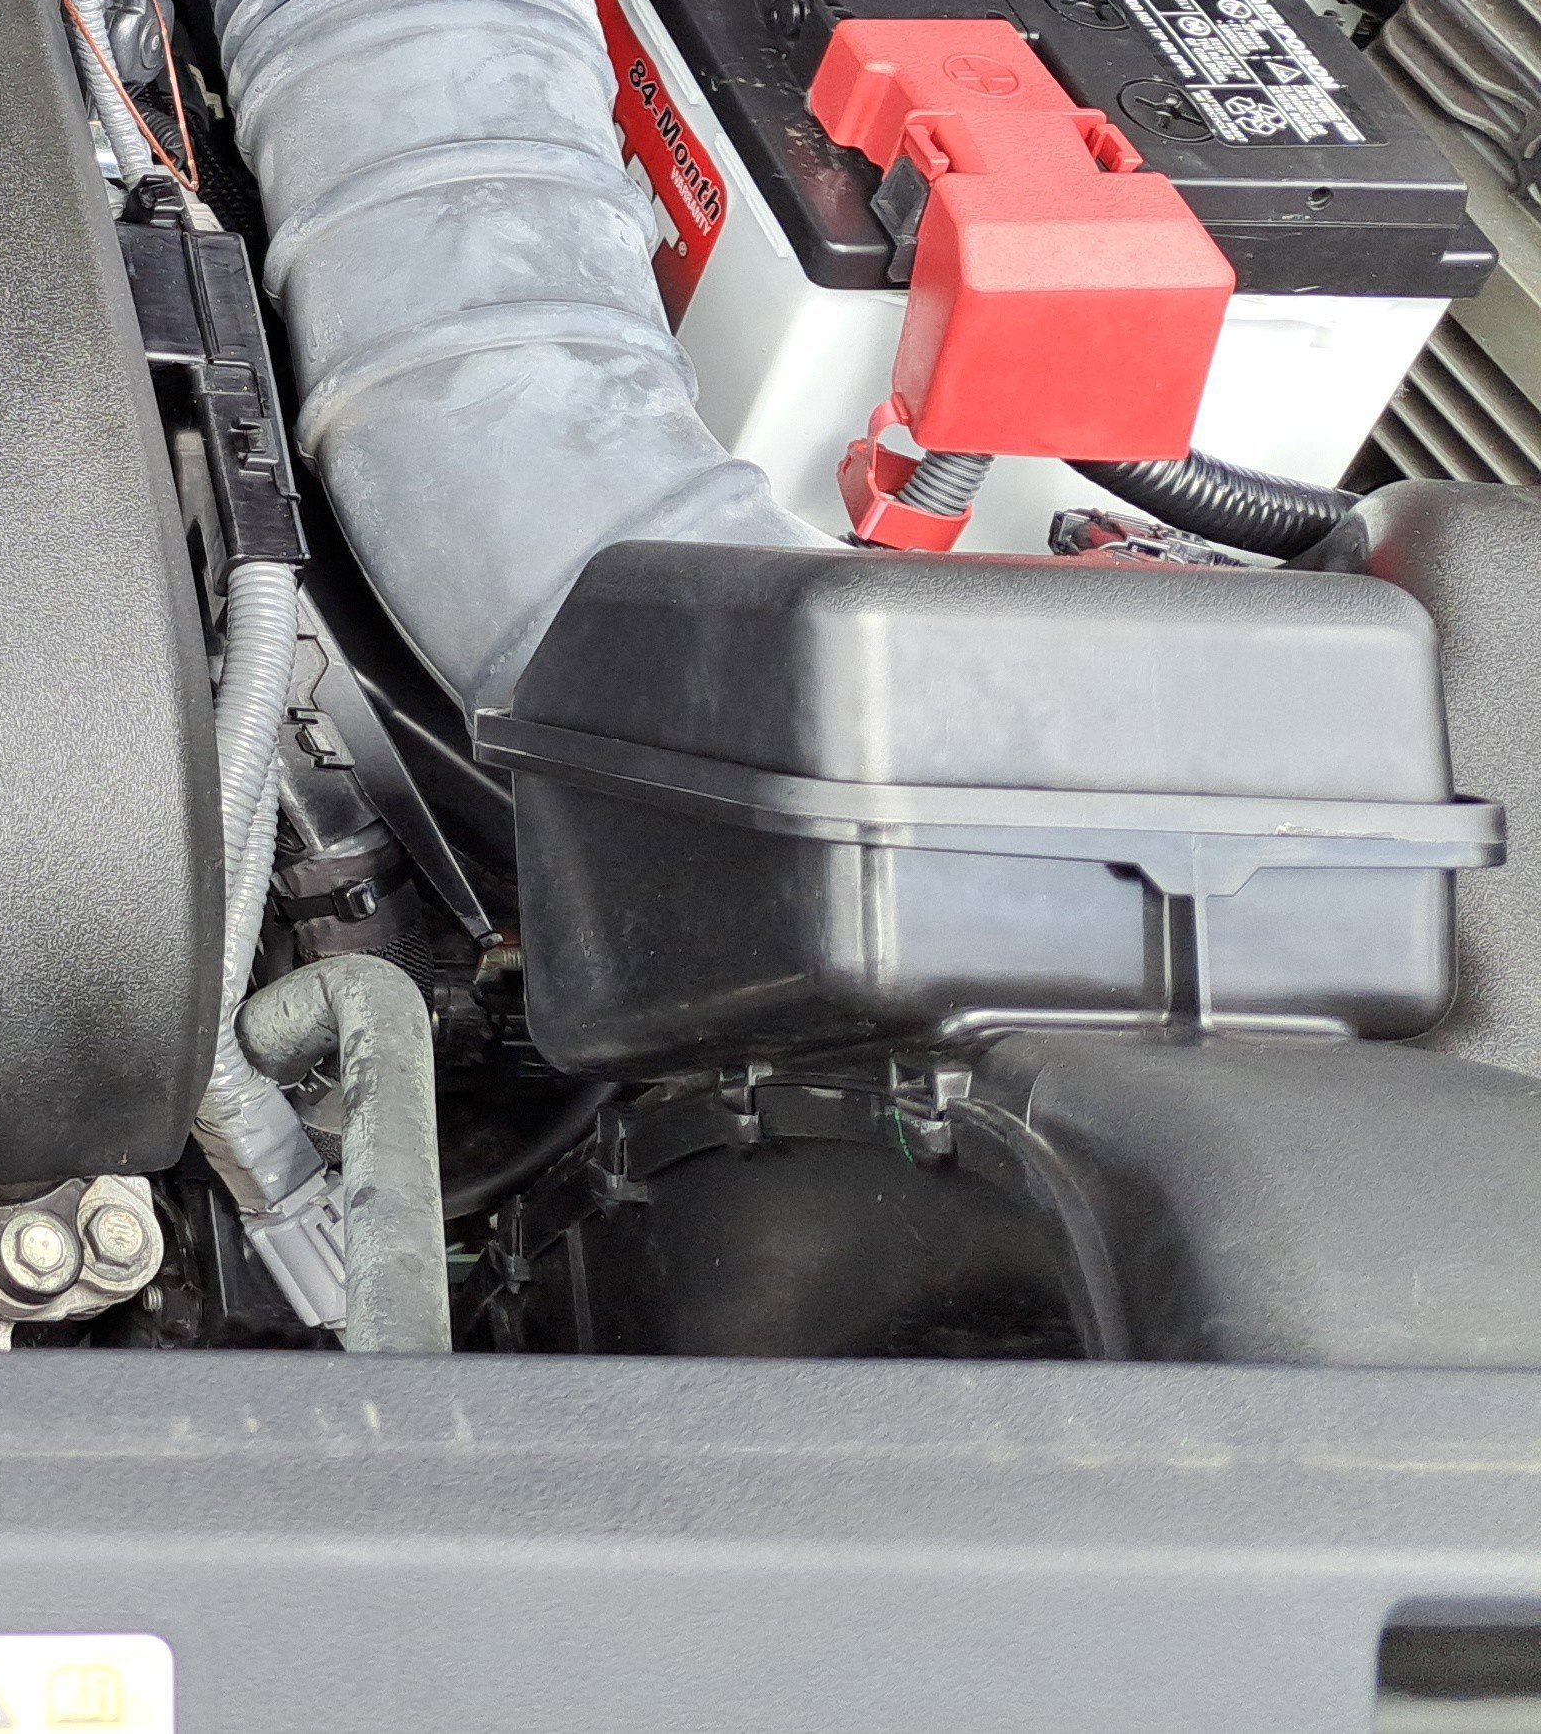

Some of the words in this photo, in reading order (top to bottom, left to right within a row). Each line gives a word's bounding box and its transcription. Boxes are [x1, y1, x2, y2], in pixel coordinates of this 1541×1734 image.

[1123, 0, 1145, 10] DO
[1132, 11, 1158, 27] NOT
[1146, 28, 1169, 40] TIP
[629, 58, 722, 226] 84-Month
[671, 166, 711, 237] WARRANTY
